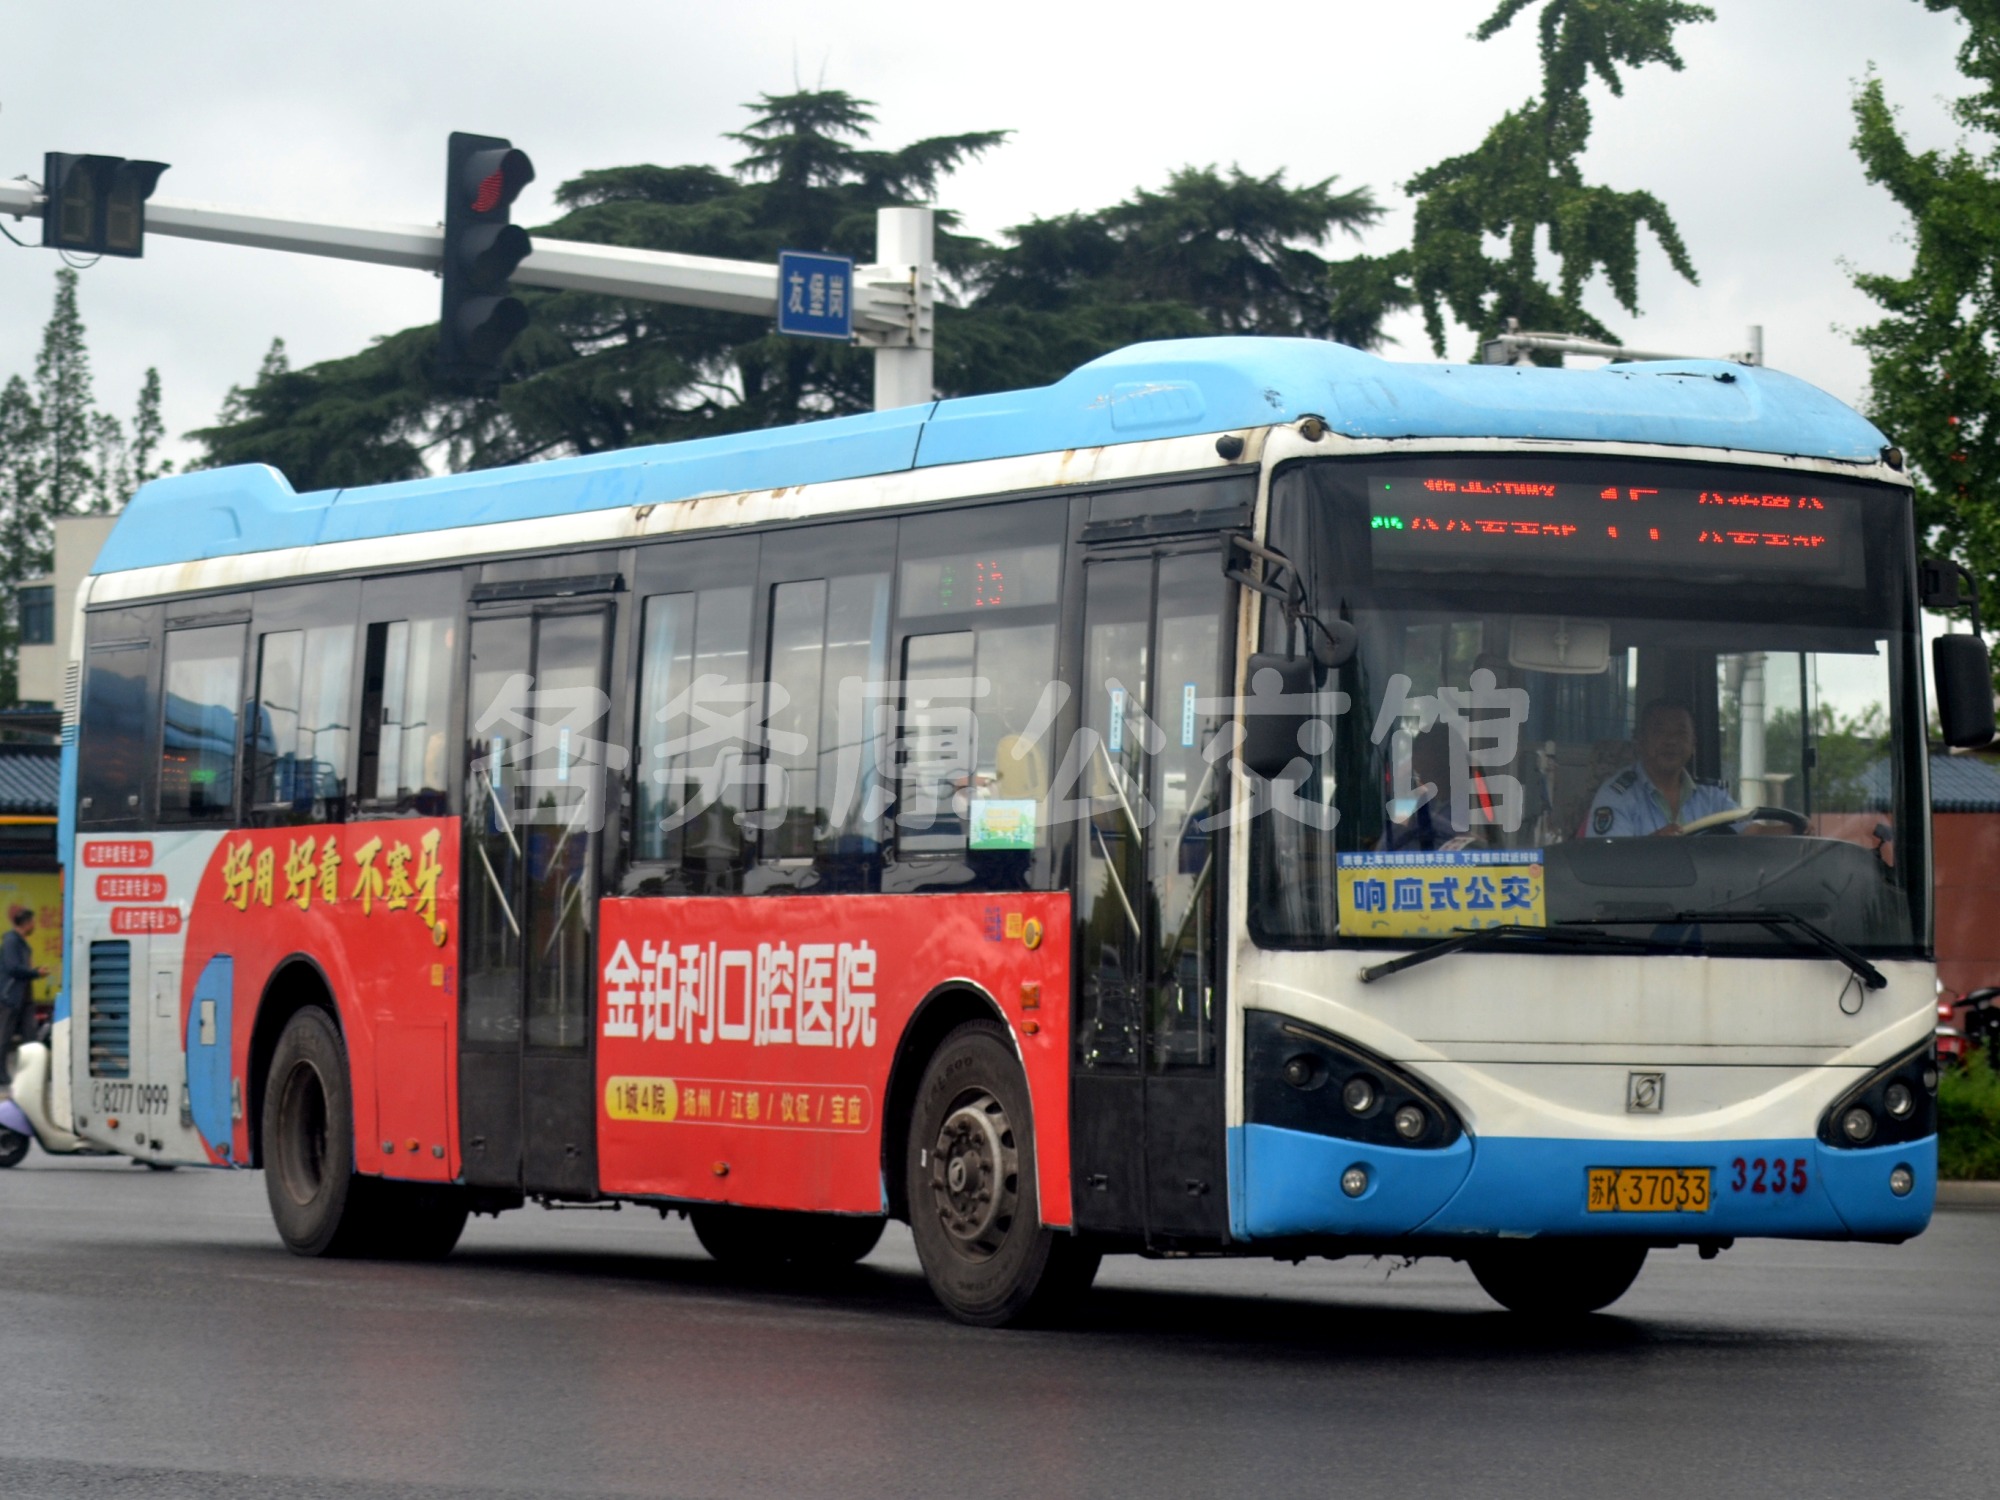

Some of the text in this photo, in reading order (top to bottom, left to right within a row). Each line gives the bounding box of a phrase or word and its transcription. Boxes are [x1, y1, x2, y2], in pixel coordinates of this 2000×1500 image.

[222, 827, 443, 929] 好用 好看 不塞牙
[1353, 876, 1532, 913] 响应式公交
[603, 939, 877, 1049] 金铂利口腔医院
[104, 1082, 168, 1115] 8277 0999
[616, 1083, 665, 1115] 1城4院
[683, 1087, 711, 1117] 扬州
[731, 1091, 760, 1120] 江都
[781, 1093, 810, 1122] 仪征
[831, 1095, 862, 1124] 宝应
[1732, 1156, 1807, 1194] 3235
